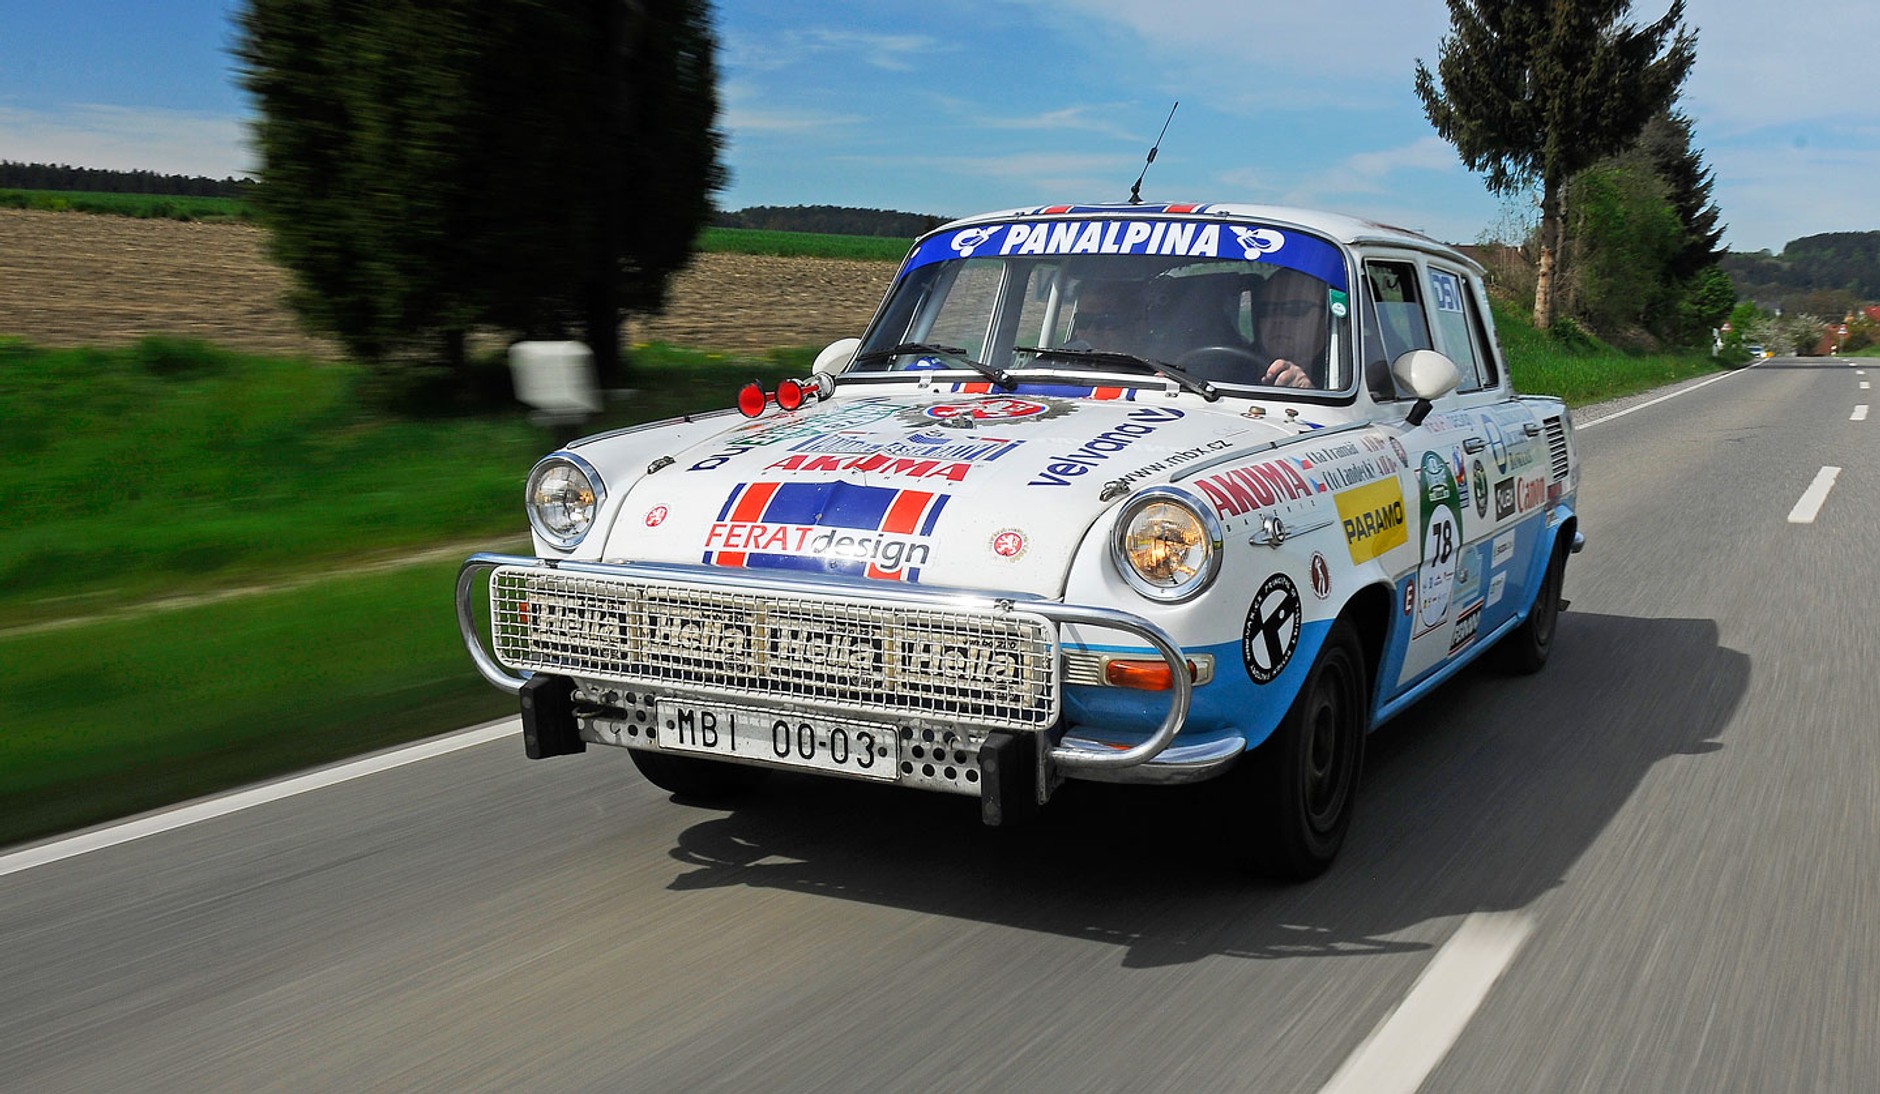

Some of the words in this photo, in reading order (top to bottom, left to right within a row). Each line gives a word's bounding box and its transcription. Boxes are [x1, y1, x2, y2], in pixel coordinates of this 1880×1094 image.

[999, 221, 1220, 257] PANALPINA
[761, 453, 973, 482] AKUMA
[1027, 423, 1157, 486] velvana
[1194, 459, 1313, 521] AKUMA
[1343, 501, 1404, 545] PARAMO
[1432, 519, 1453, 567] 78
[655, 612, 746, 655] Hella
[777, 626, 875, 670] Hella
[910, 640, 1016, 686] Hella
[772, 719, 875, 769] 00-03
